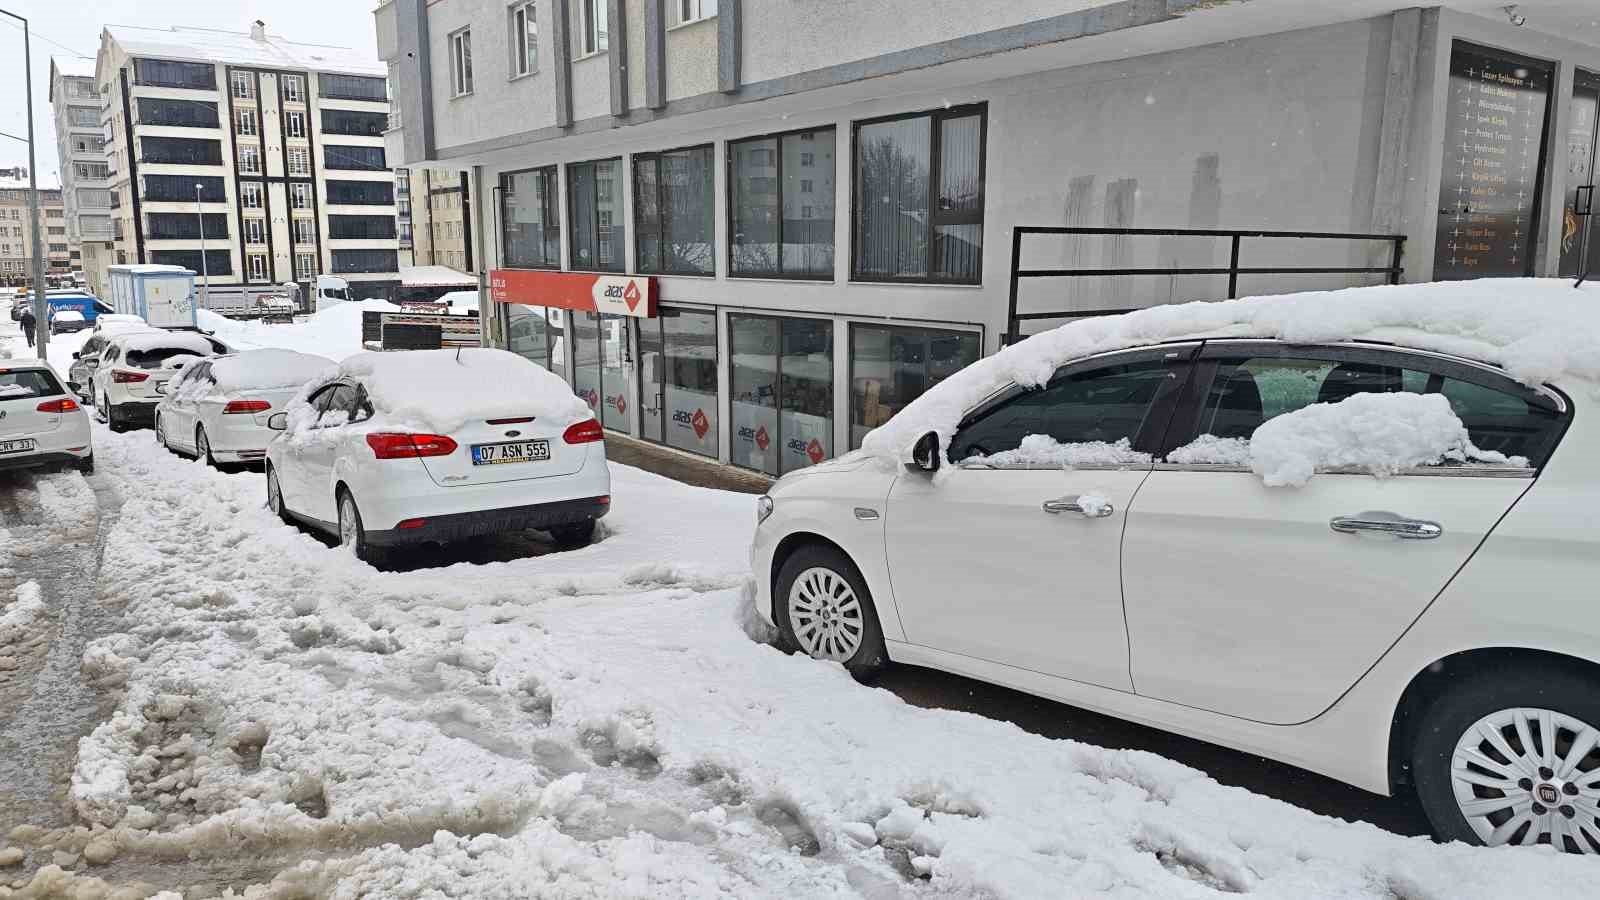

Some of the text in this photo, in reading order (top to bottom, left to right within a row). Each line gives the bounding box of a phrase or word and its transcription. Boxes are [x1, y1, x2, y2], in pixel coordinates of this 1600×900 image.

[481, 447, 495, 460] 07
[501, 444, 523, 458] ASN
[527, 443, 546, 457] 555
